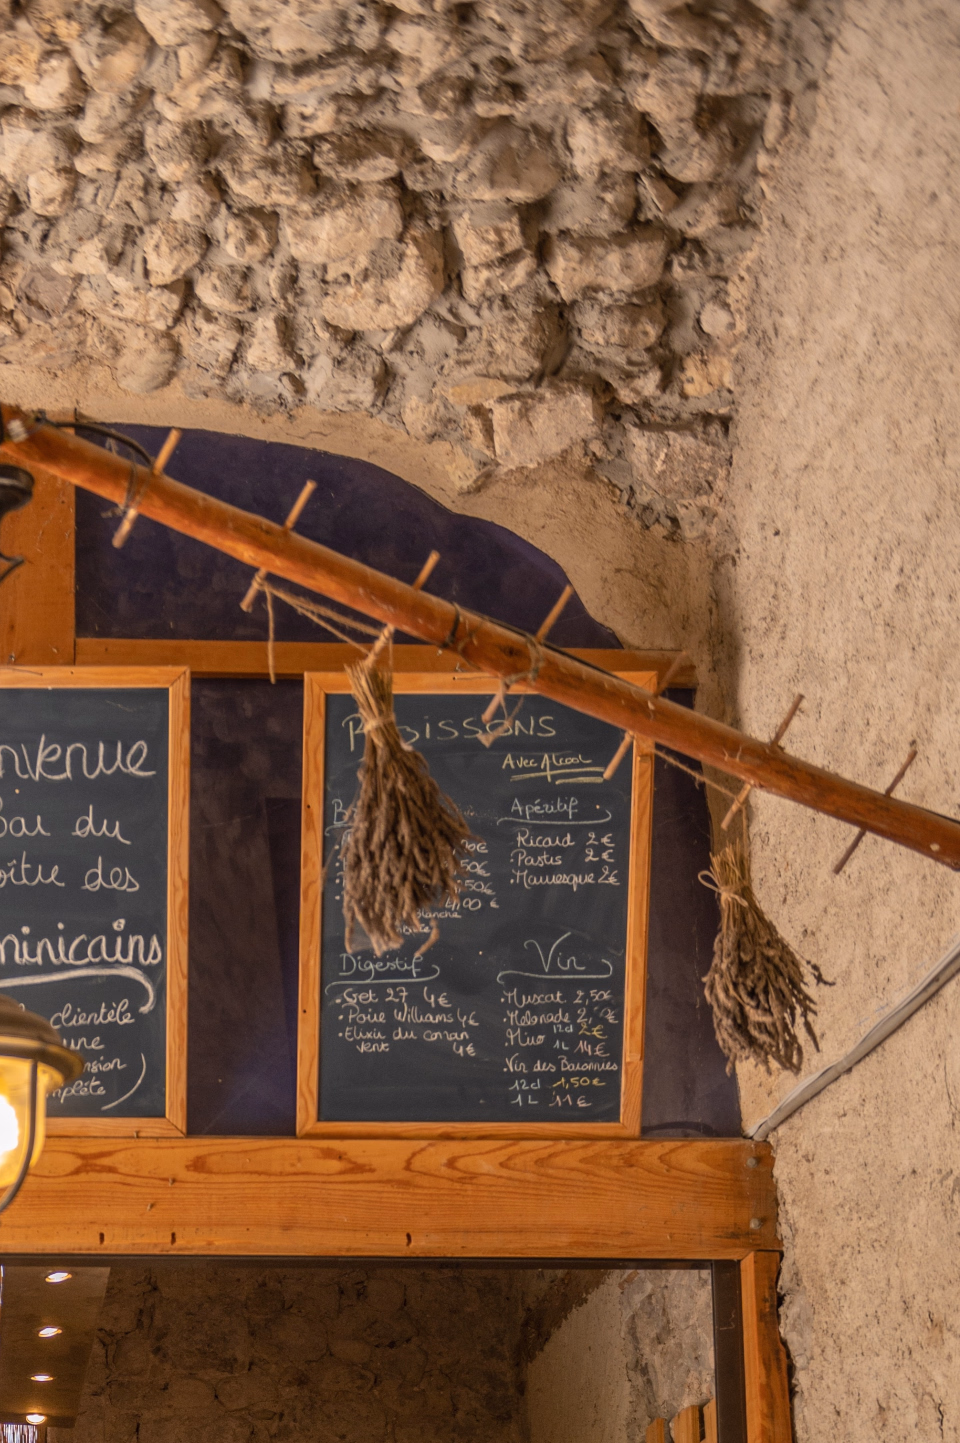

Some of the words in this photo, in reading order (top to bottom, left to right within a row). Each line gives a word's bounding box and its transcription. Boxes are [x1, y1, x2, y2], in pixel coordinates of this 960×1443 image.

[71, 804, 131, 844] du
[517, 828, 575, 848] Ricard
[511, 848, 562, 867] Pastis
[81, 855, 140, 892] des
[524, 932, 586, 972] Vin
[339, 953, 423, 981] Digestif
[385, 987, 408, 1002] 27
[393, 1027, 417, 1040] du
[506, 1053, 528, 1073] Vin
[533, 1060, 556, 1072] des
